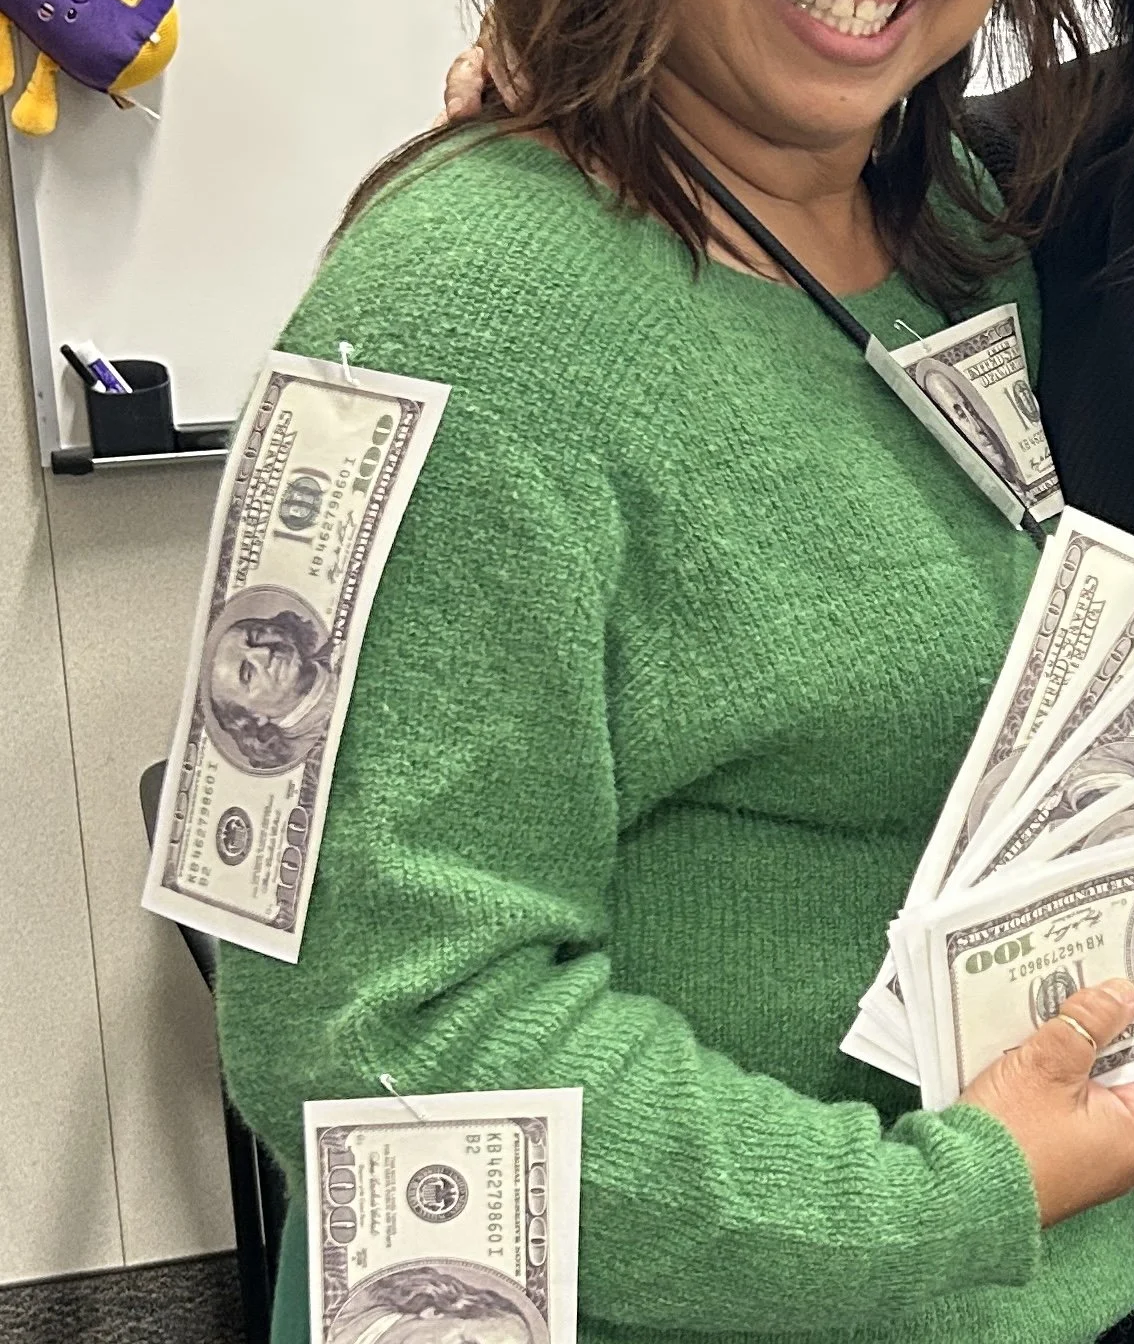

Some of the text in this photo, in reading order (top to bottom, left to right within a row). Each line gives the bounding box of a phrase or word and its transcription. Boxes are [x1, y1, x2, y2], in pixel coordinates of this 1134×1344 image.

[351, 413, 394, 499] 100
[276, 805, 309, 906] 100
[1032, 883, 1109, 920] HUNDRED
[957, 911, 1032, 947] DOLLARS
[964, 931, 1036, 975] 100
[465, 1133, 482, 1155] B2
[326, 1144, 358, 1245] 100
